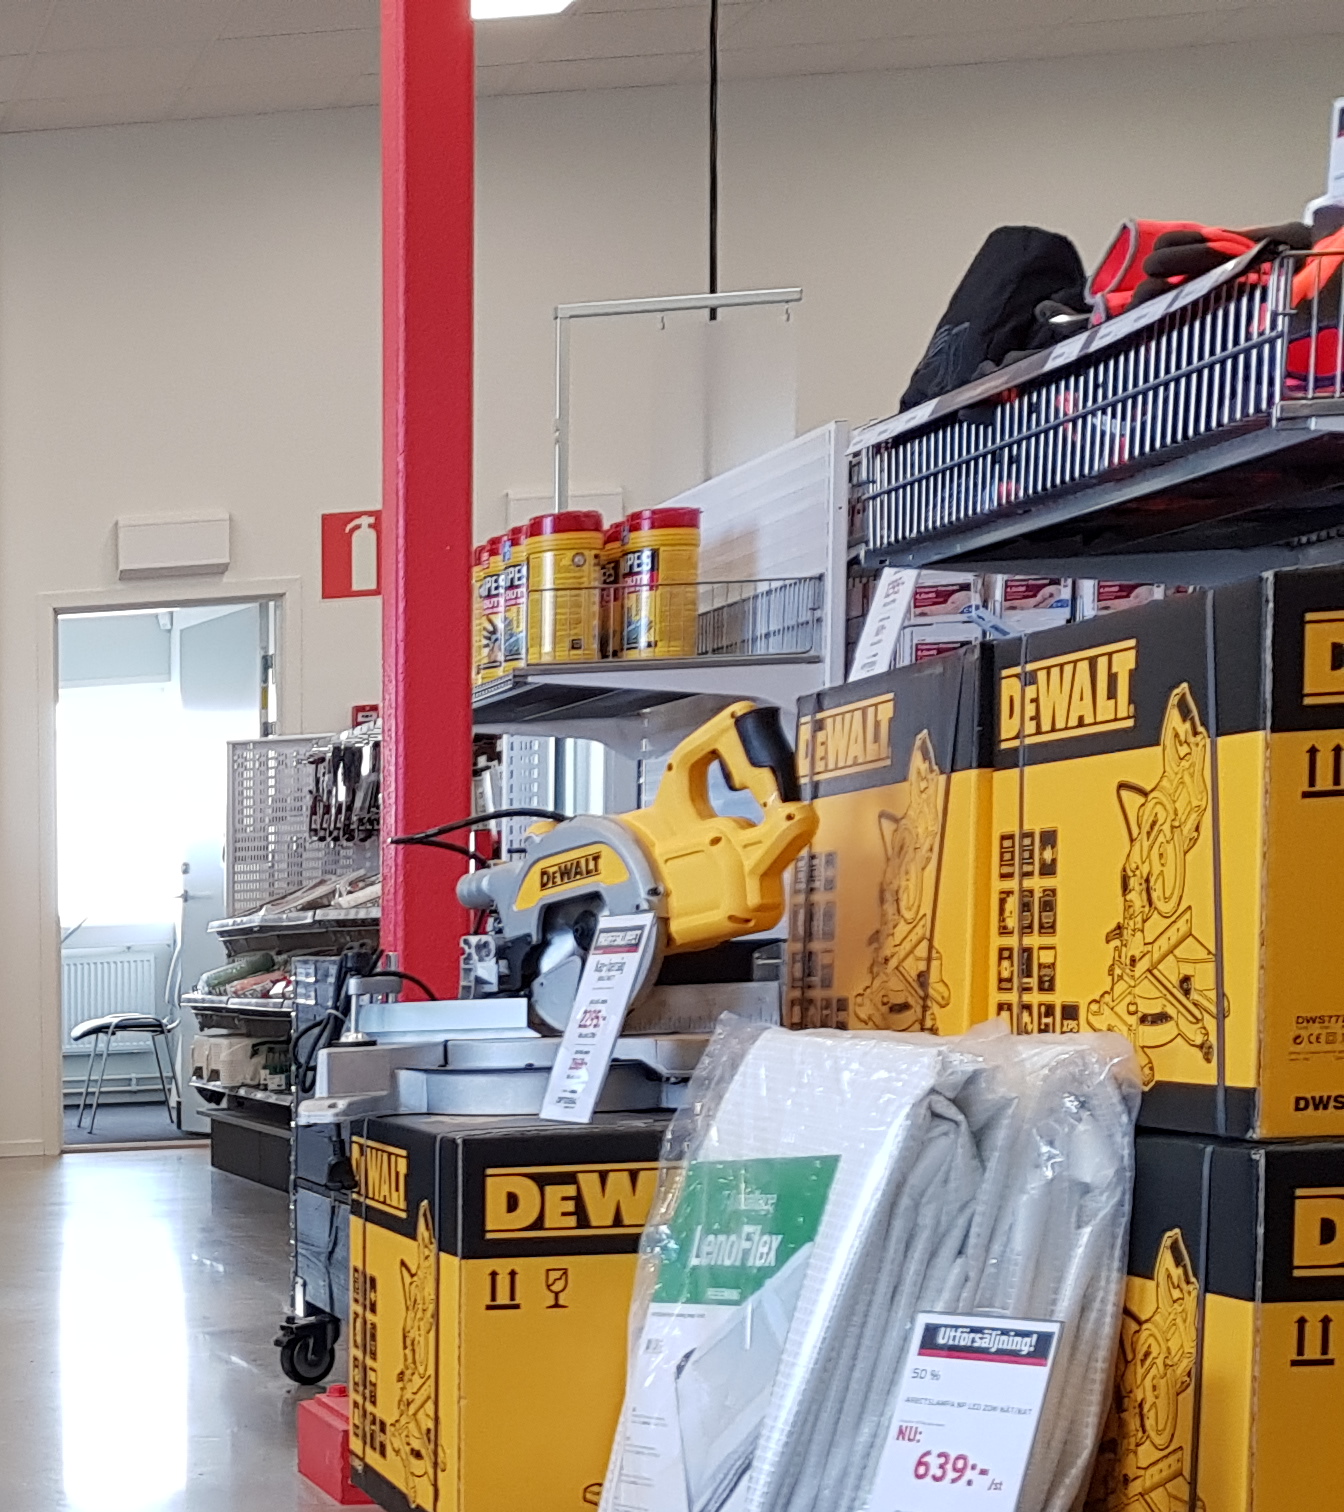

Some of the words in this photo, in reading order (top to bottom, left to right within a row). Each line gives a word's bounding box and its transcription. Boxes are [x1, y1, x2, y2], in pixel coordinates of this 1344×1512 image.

[1295, 1014, 1344, 1025] DWS77
[1294, 1094, 1344, 1112] DWS
[484, 1169, 659, 1232] DEW
[690, 1223, 784, 1267] LenoFlex
[937, 1326, 1037, 1355] Utförsäljning!
[911, 1368, 928, 1380] 50
[895, 1424, 923, 1444] NU:
